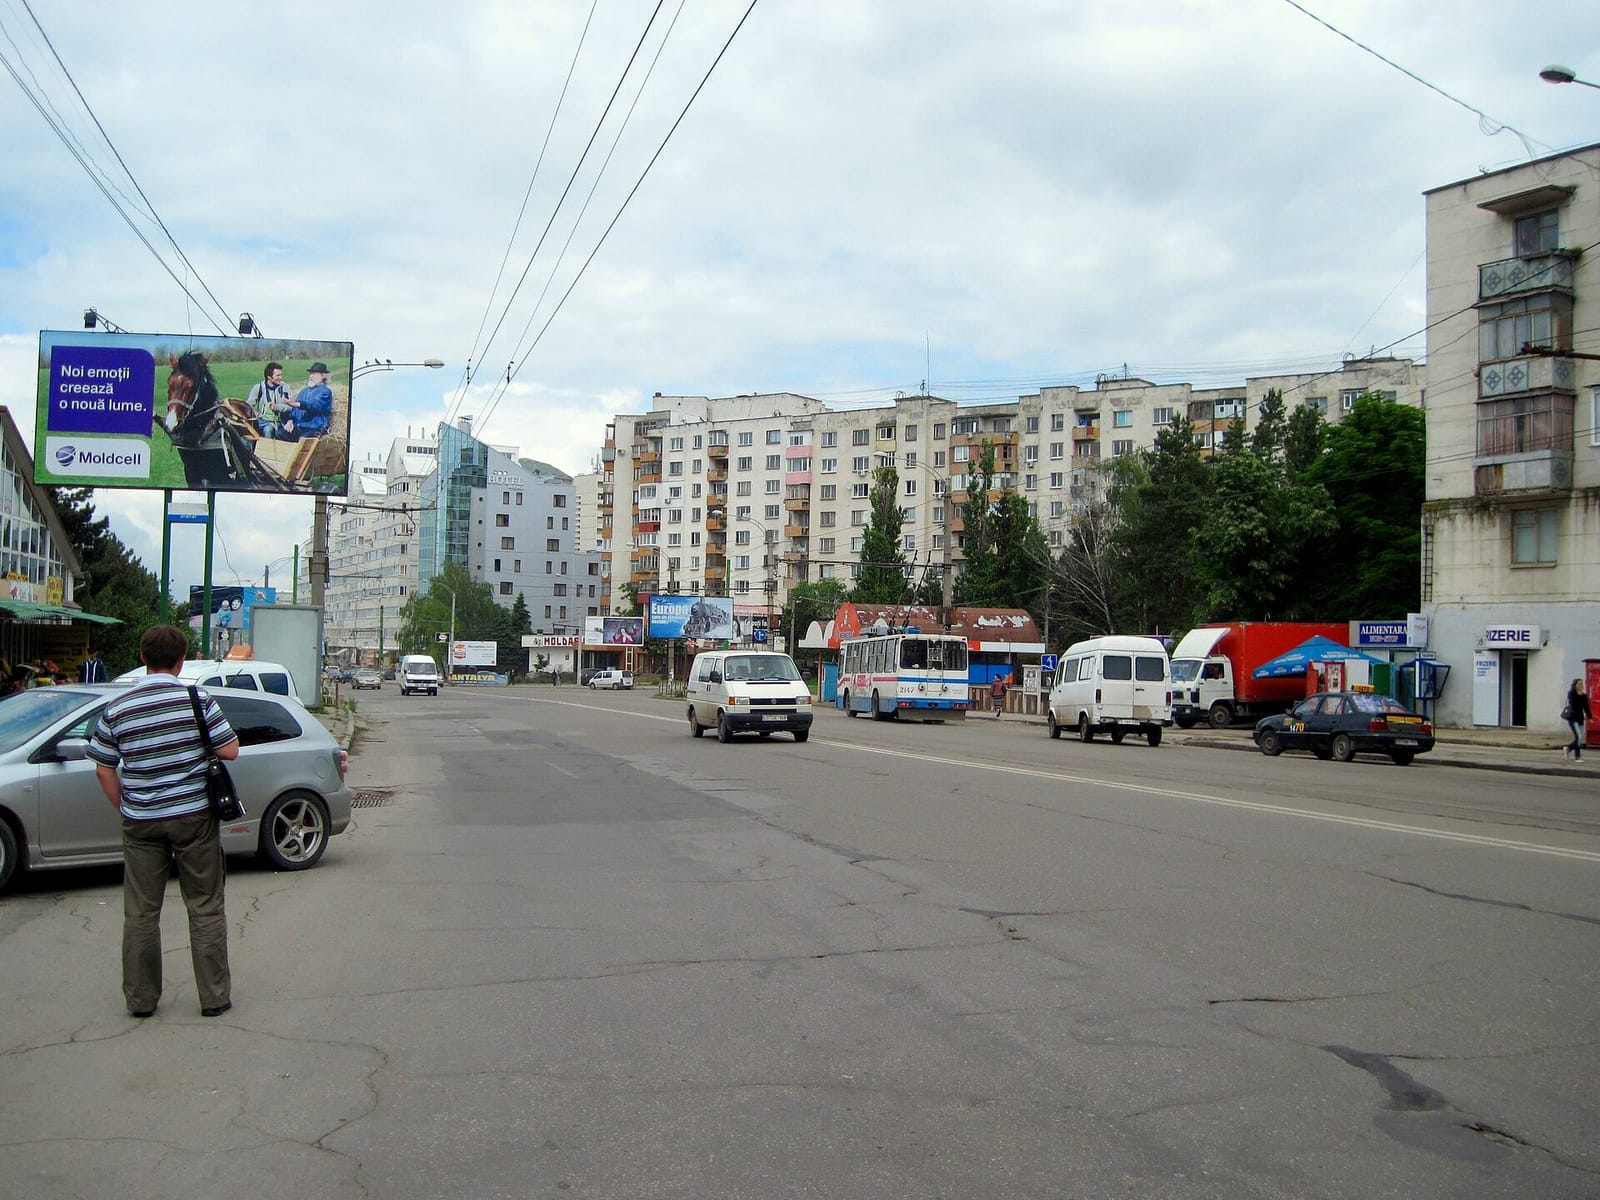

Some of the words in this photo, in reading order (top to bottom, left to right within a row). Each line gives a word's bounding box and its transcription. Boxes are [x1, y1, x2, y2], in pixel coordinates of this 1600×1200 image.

[61, 365, 84, 377] Noi
[60, 383, 114, 395] creează
[59, 400, 68, 409] o
[71, 398, 105, 410] nouă
[109, 399, 147, 412] lume.
[79, 451, 141, 465] Moldcell
[651, 601, 689, 616] Europa
[1360, 625, 1408, 635] ALIMENTARA
